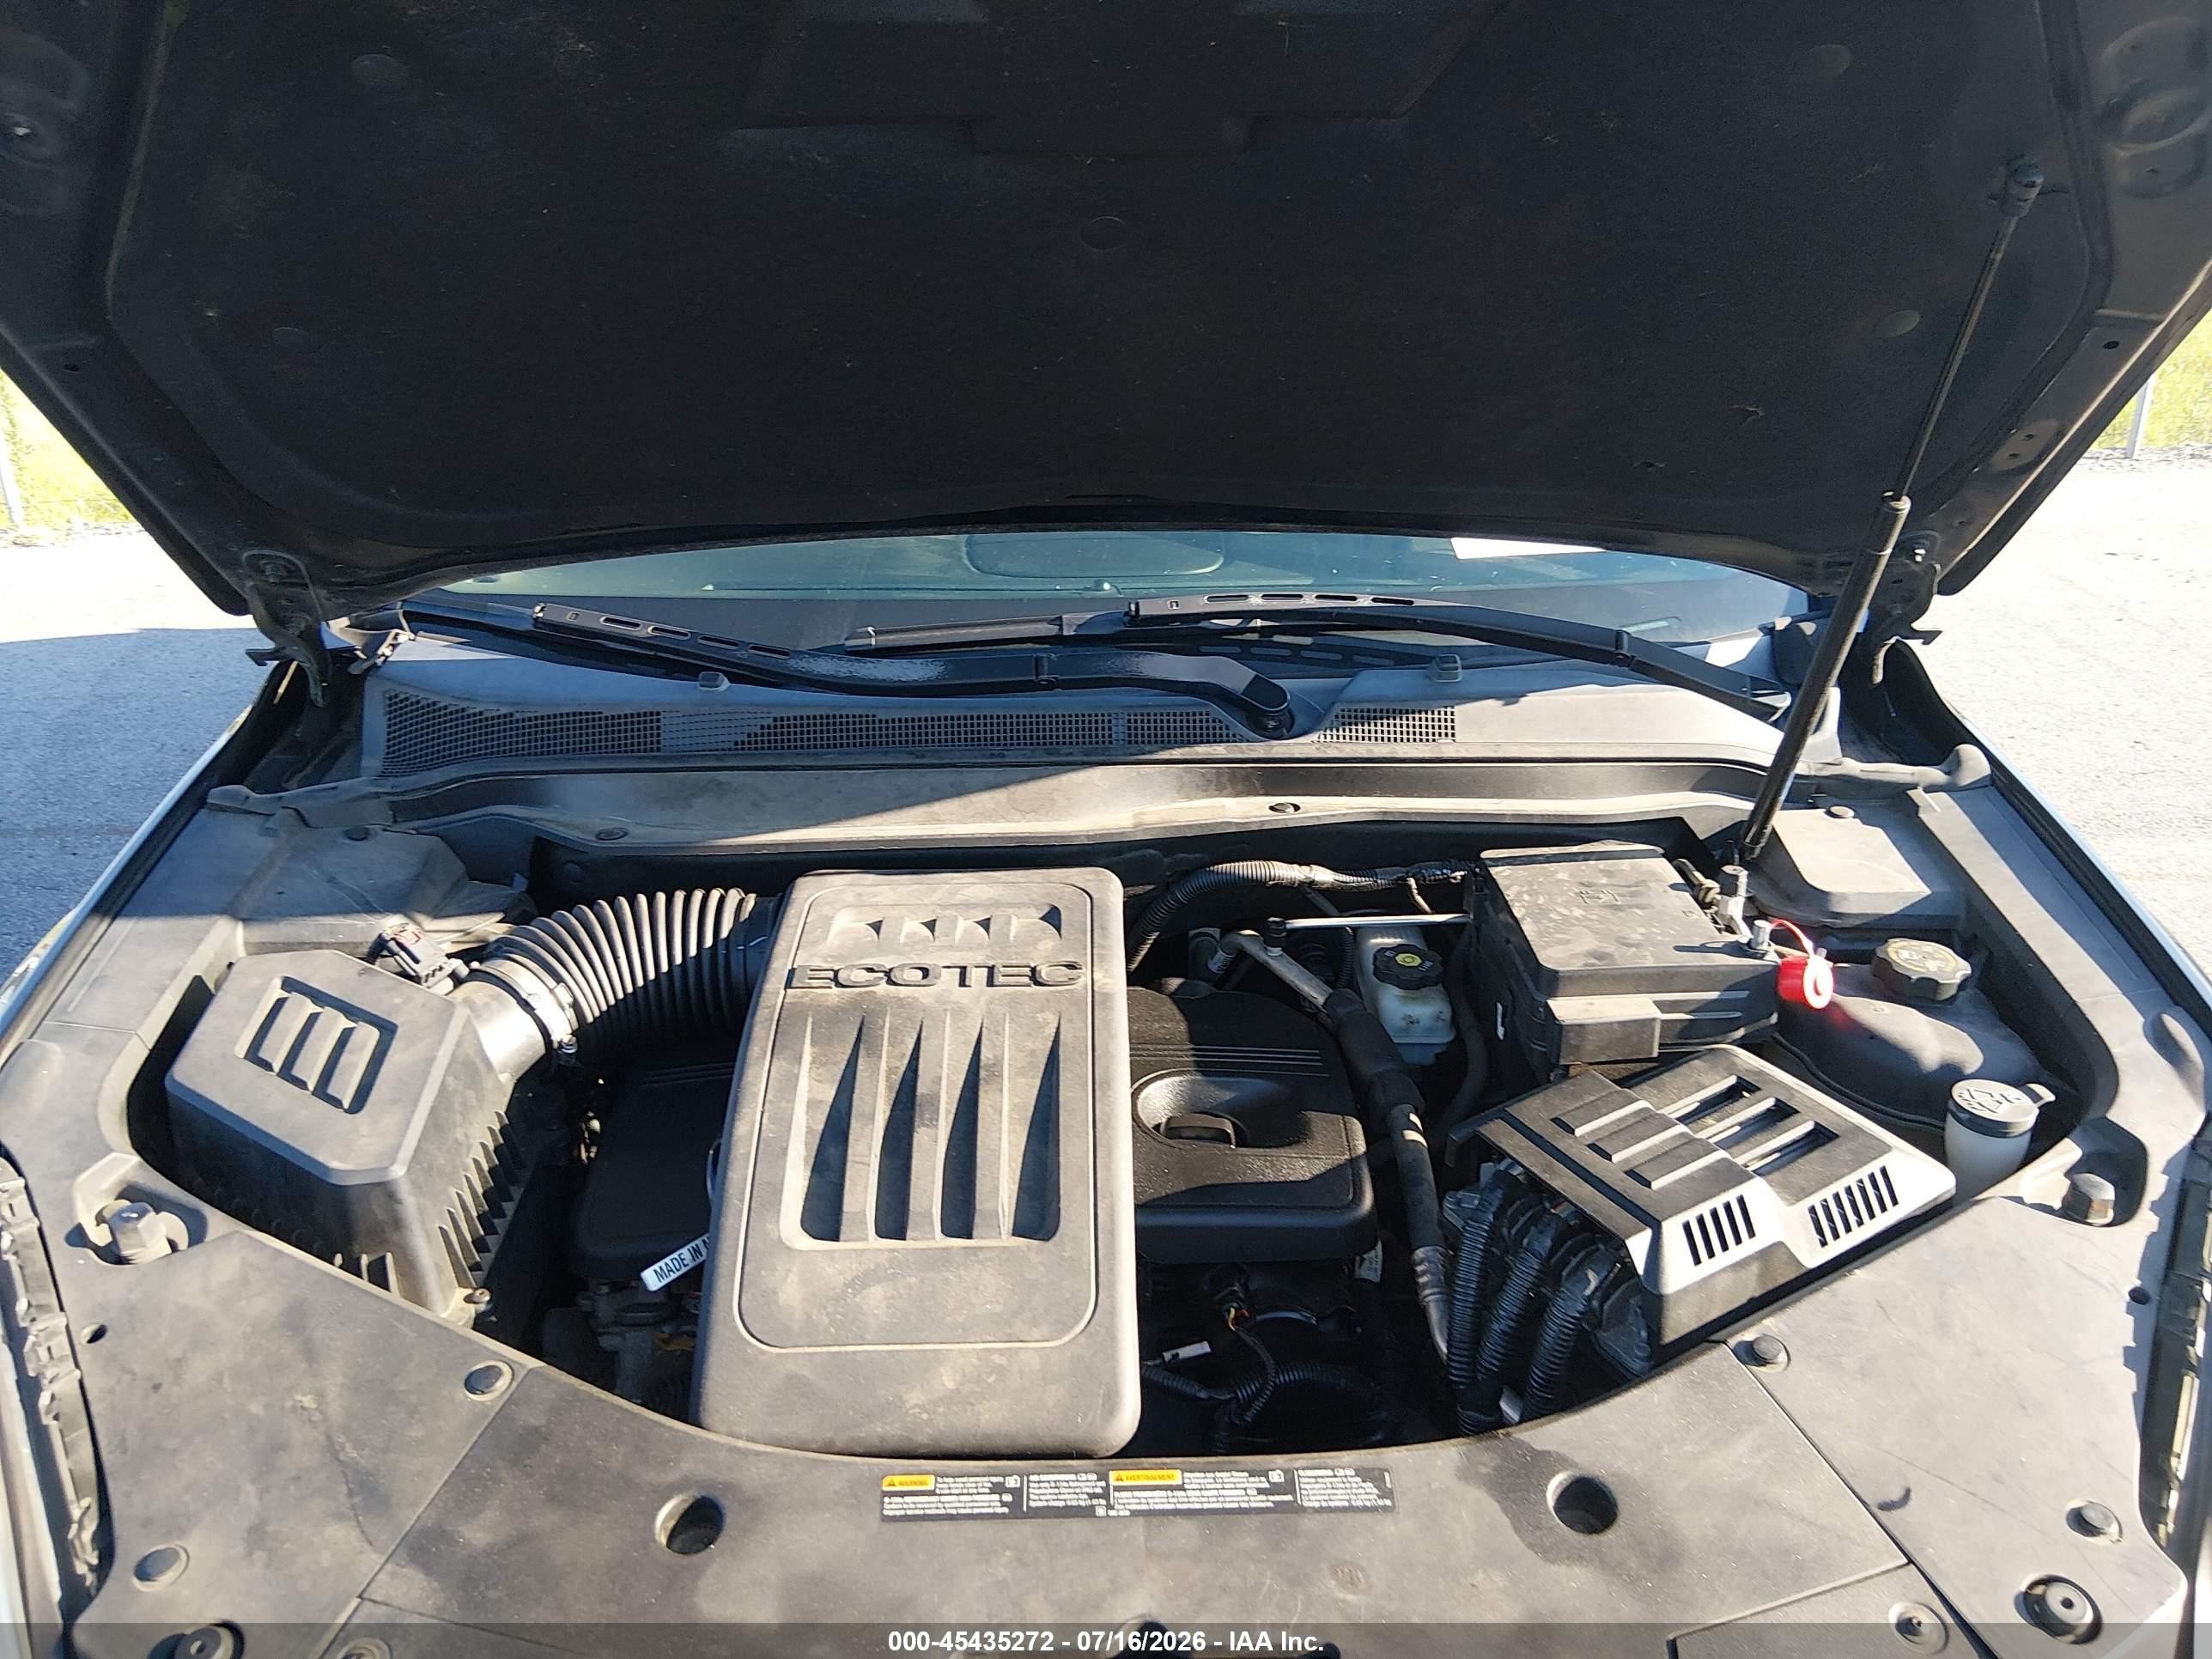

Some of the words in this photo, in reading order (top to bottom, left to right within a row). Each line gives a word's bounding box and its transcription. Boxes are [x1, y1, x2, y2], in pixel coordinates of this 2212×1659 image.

[786, 960, 1085, 988] ECOTEC
[653, 1253, 689, 1283] MADE
[688, 1244, 702, 1261] IN
